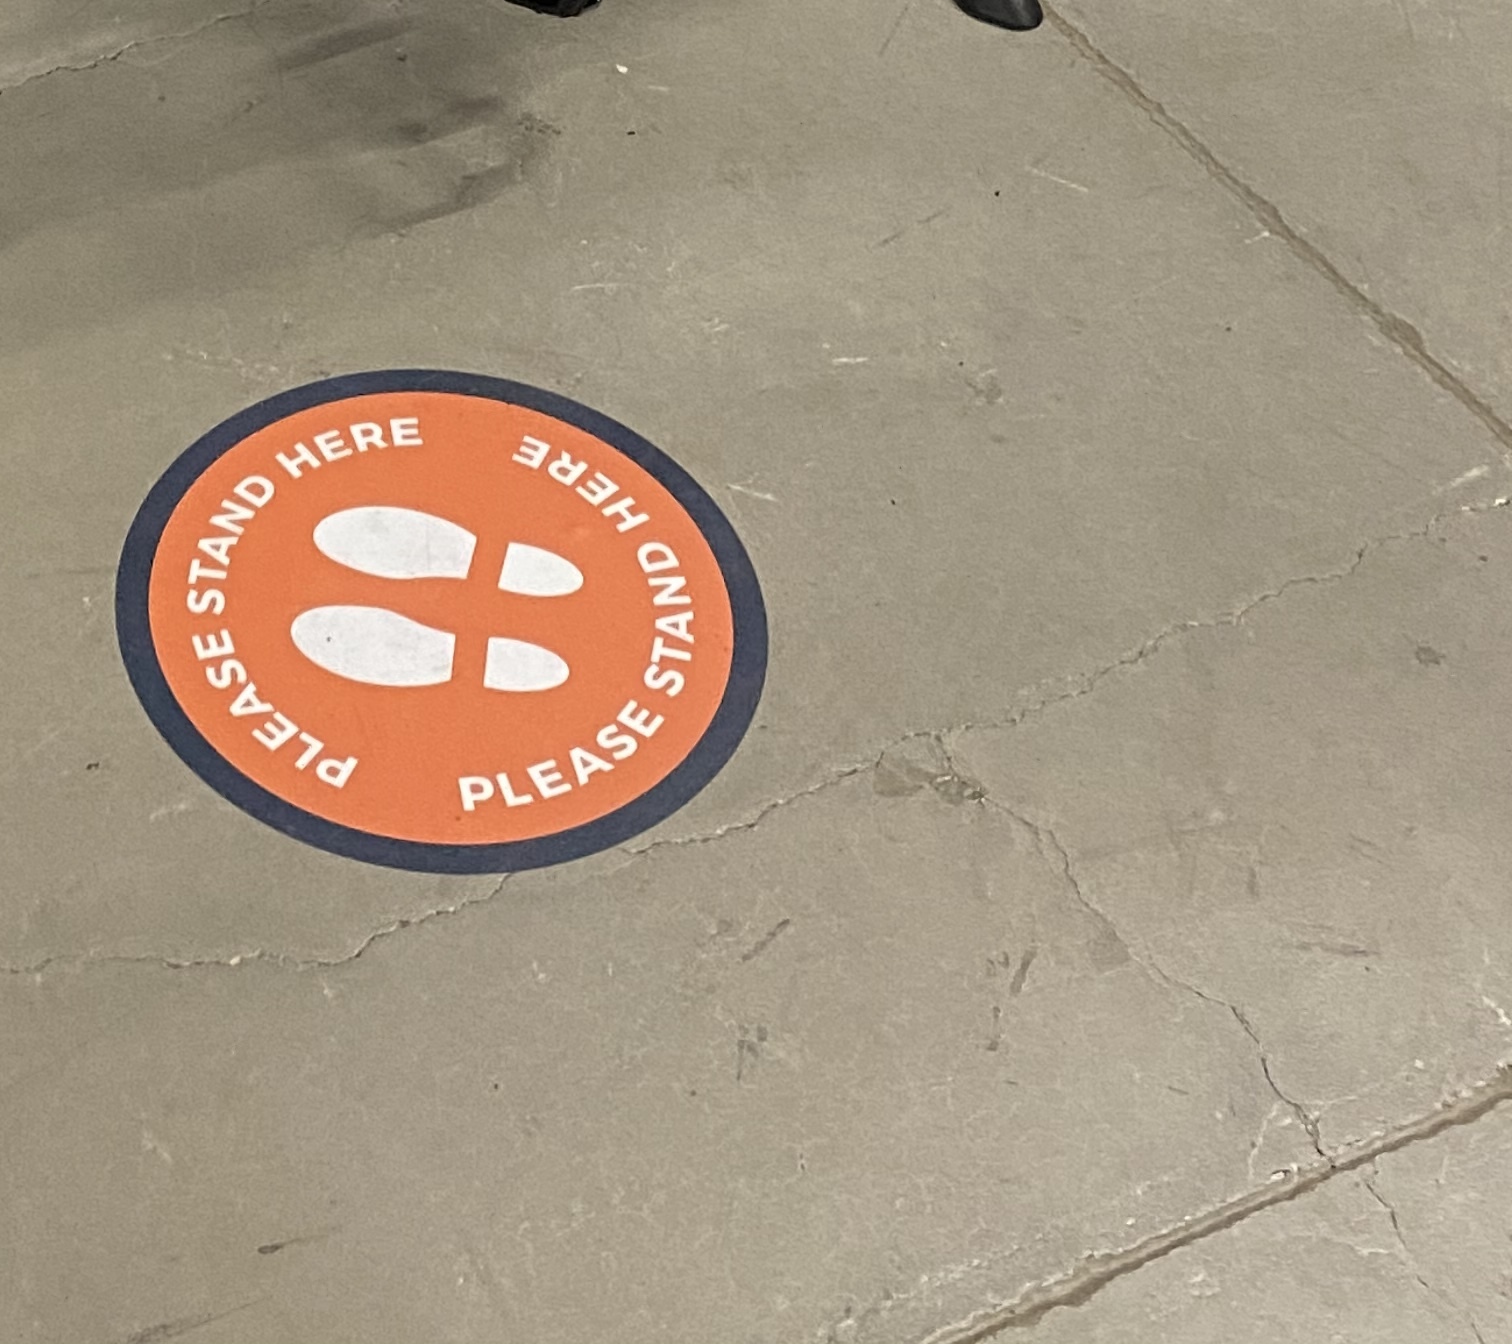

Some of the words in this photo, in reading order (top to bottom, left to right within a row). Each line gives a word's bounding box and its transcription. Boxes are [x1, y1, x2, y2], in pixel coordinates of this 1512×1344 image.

[275, 417, 424, 478] HERE
[511, 435, 650, 533] HERE
[188, 474, 275, 615] STAND
[636, 541, 695, 698] STAND
[192, 627, 359, 788] PLEASE
[457, 699, 665, 812] PLEASE
